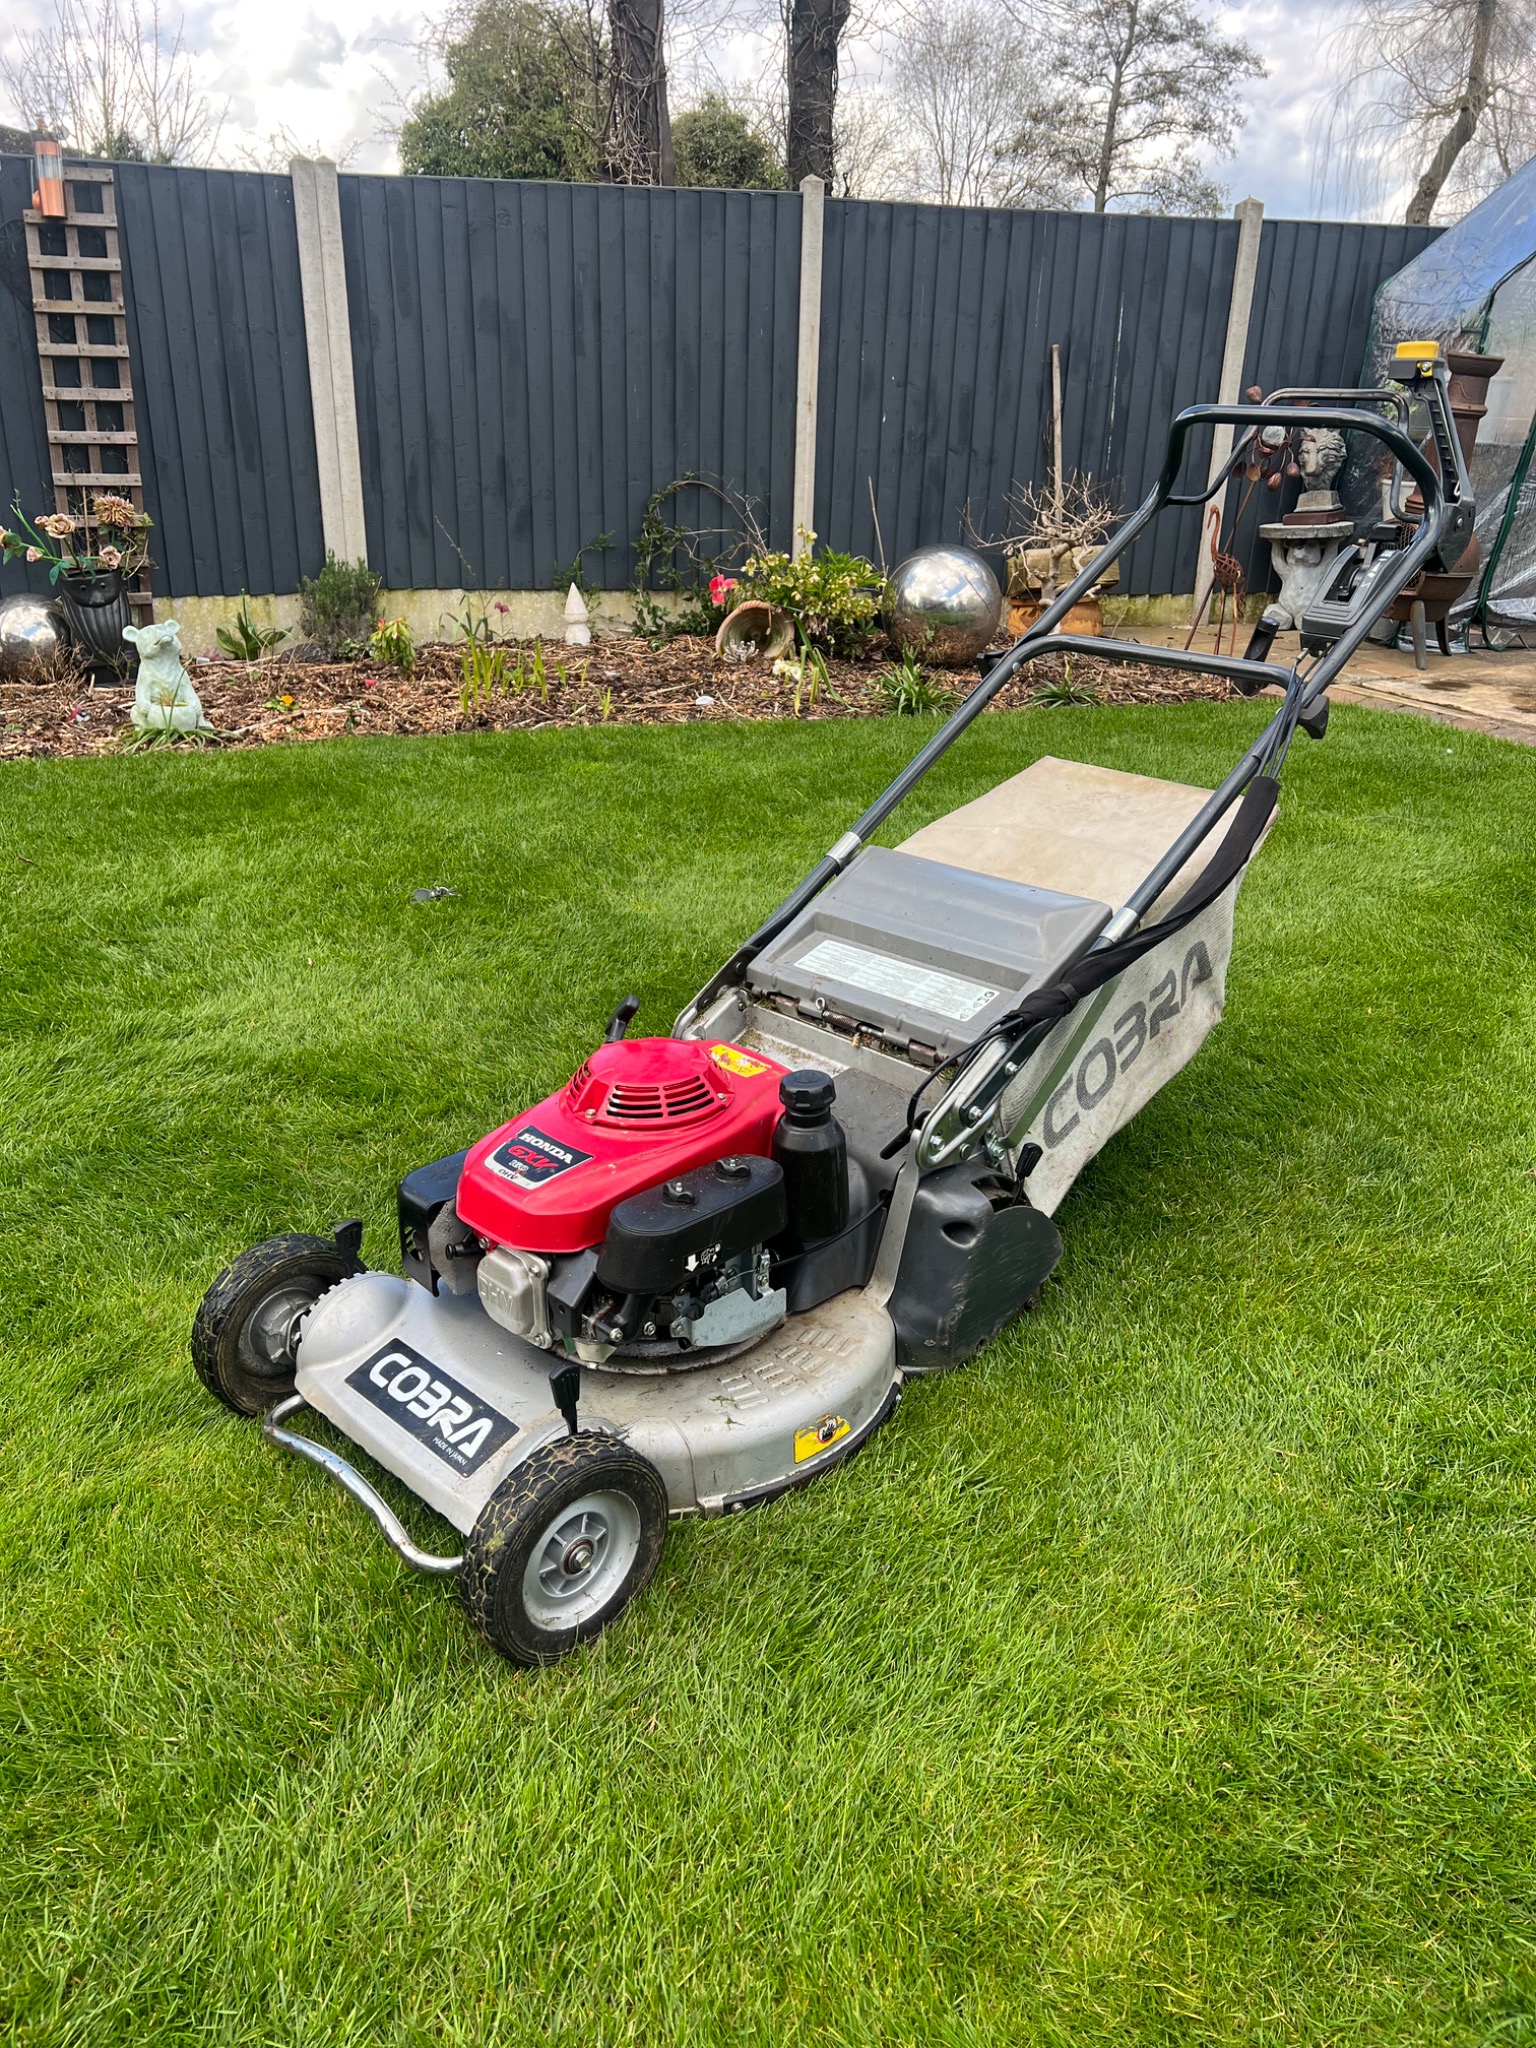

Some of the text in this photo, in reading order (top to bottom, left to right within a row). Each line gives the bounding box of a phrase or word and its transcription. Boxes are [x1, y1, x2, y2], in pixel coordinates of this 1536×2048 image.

[1042, 940, 1213, 1149] COBRA
[508, 1145, 559, 1169] GXV
[518, 1132, 574, 1164] HONDA
[369, 1352, 493, 1459] COBRA
[432, 1436, 468, 1466] MADE IN JAPAN
